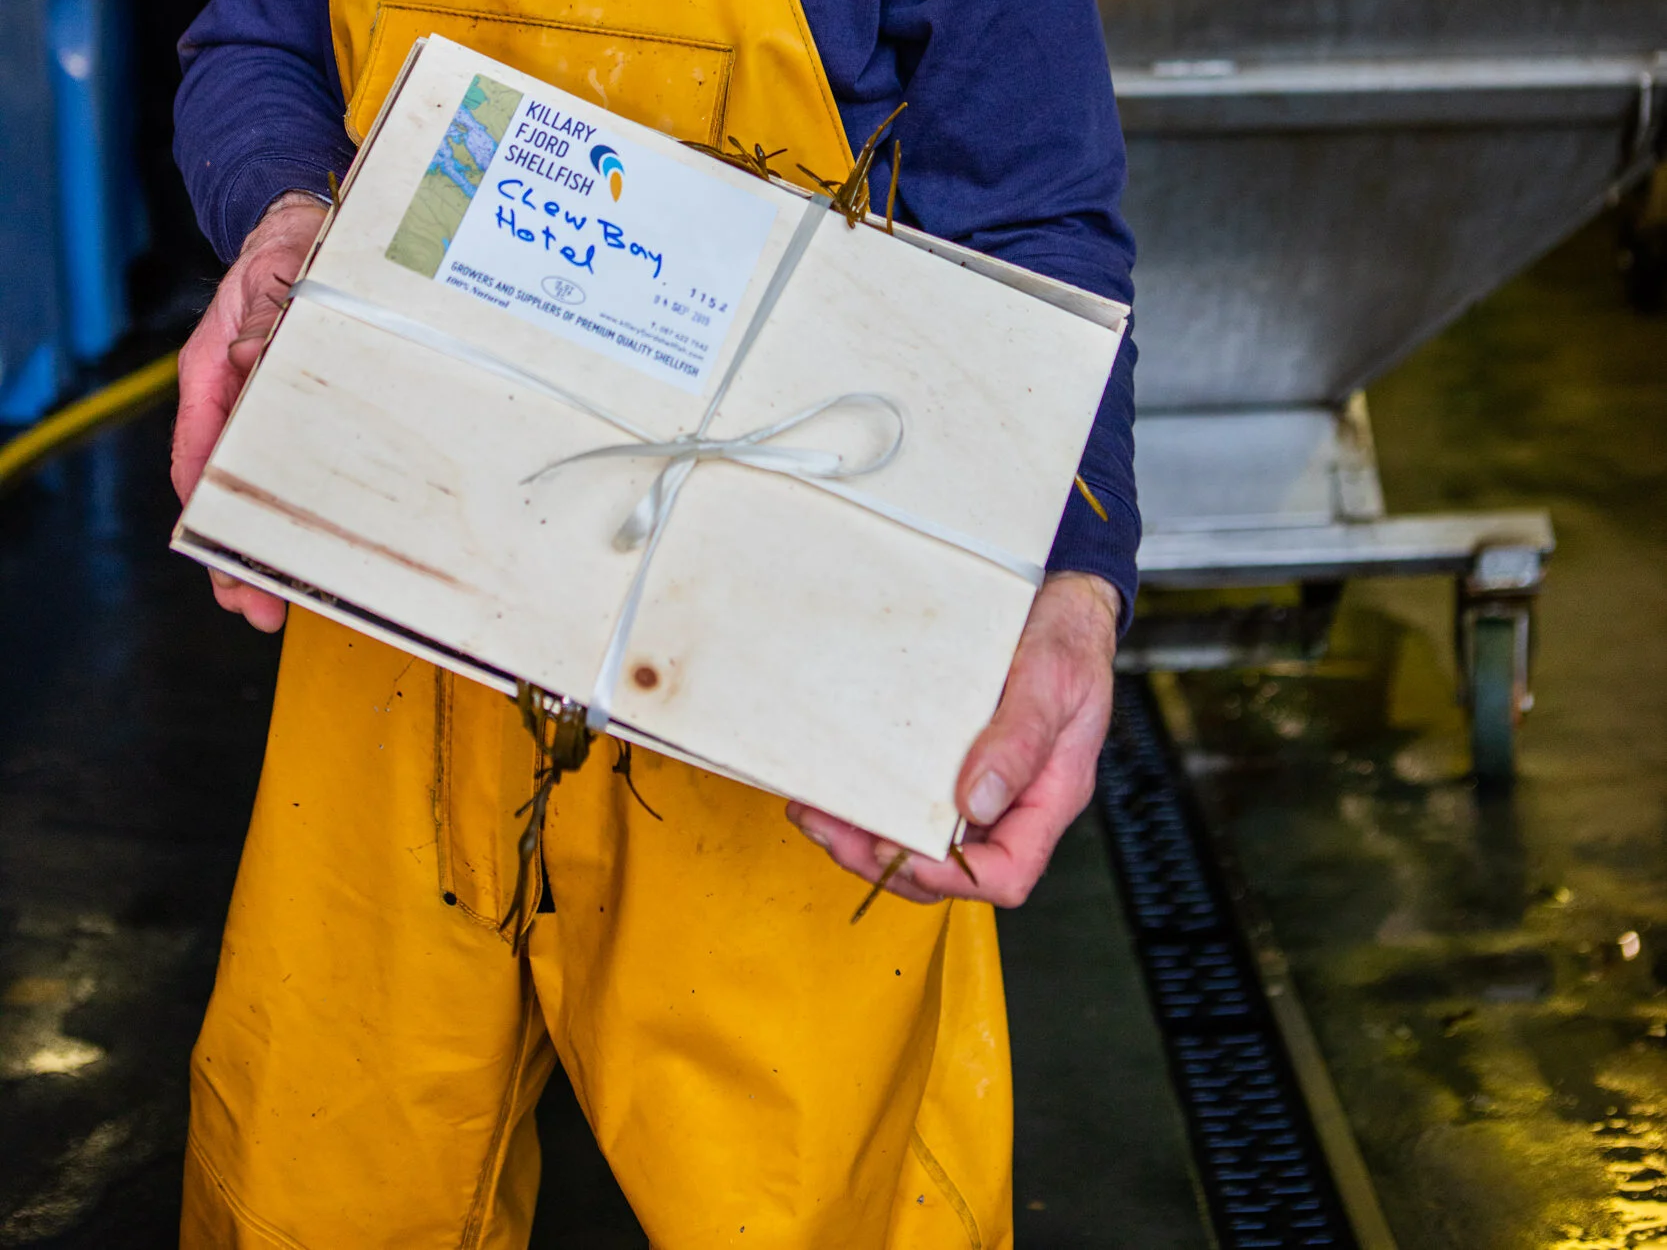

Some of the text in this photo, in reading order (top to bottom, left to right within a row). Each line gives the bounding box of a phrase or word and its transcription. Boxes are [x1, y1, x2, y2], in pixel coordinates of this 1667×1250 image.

[515, 123, 570, 158] FJORD
[525, 101, 597, 143] KILLARY
[504, 145, 595, 196] SHELLFISH
[495, 205, 595, 275] Hotel
[446, 276, 510, 308] 100% Natural
[690, 288, 728, 312] 1152
[451, 261, 495, 288] GROWERS
[495, 281, 515, 296] AND
[515, 290, 561, 317] SUPPLIERS
[562, 307, 575, 321] OF
[575, 314, 616, 340] PREMIUM
[616, 334, 653, 356] QUALITY
[653, 350, 699, 378] SHELLFISH
